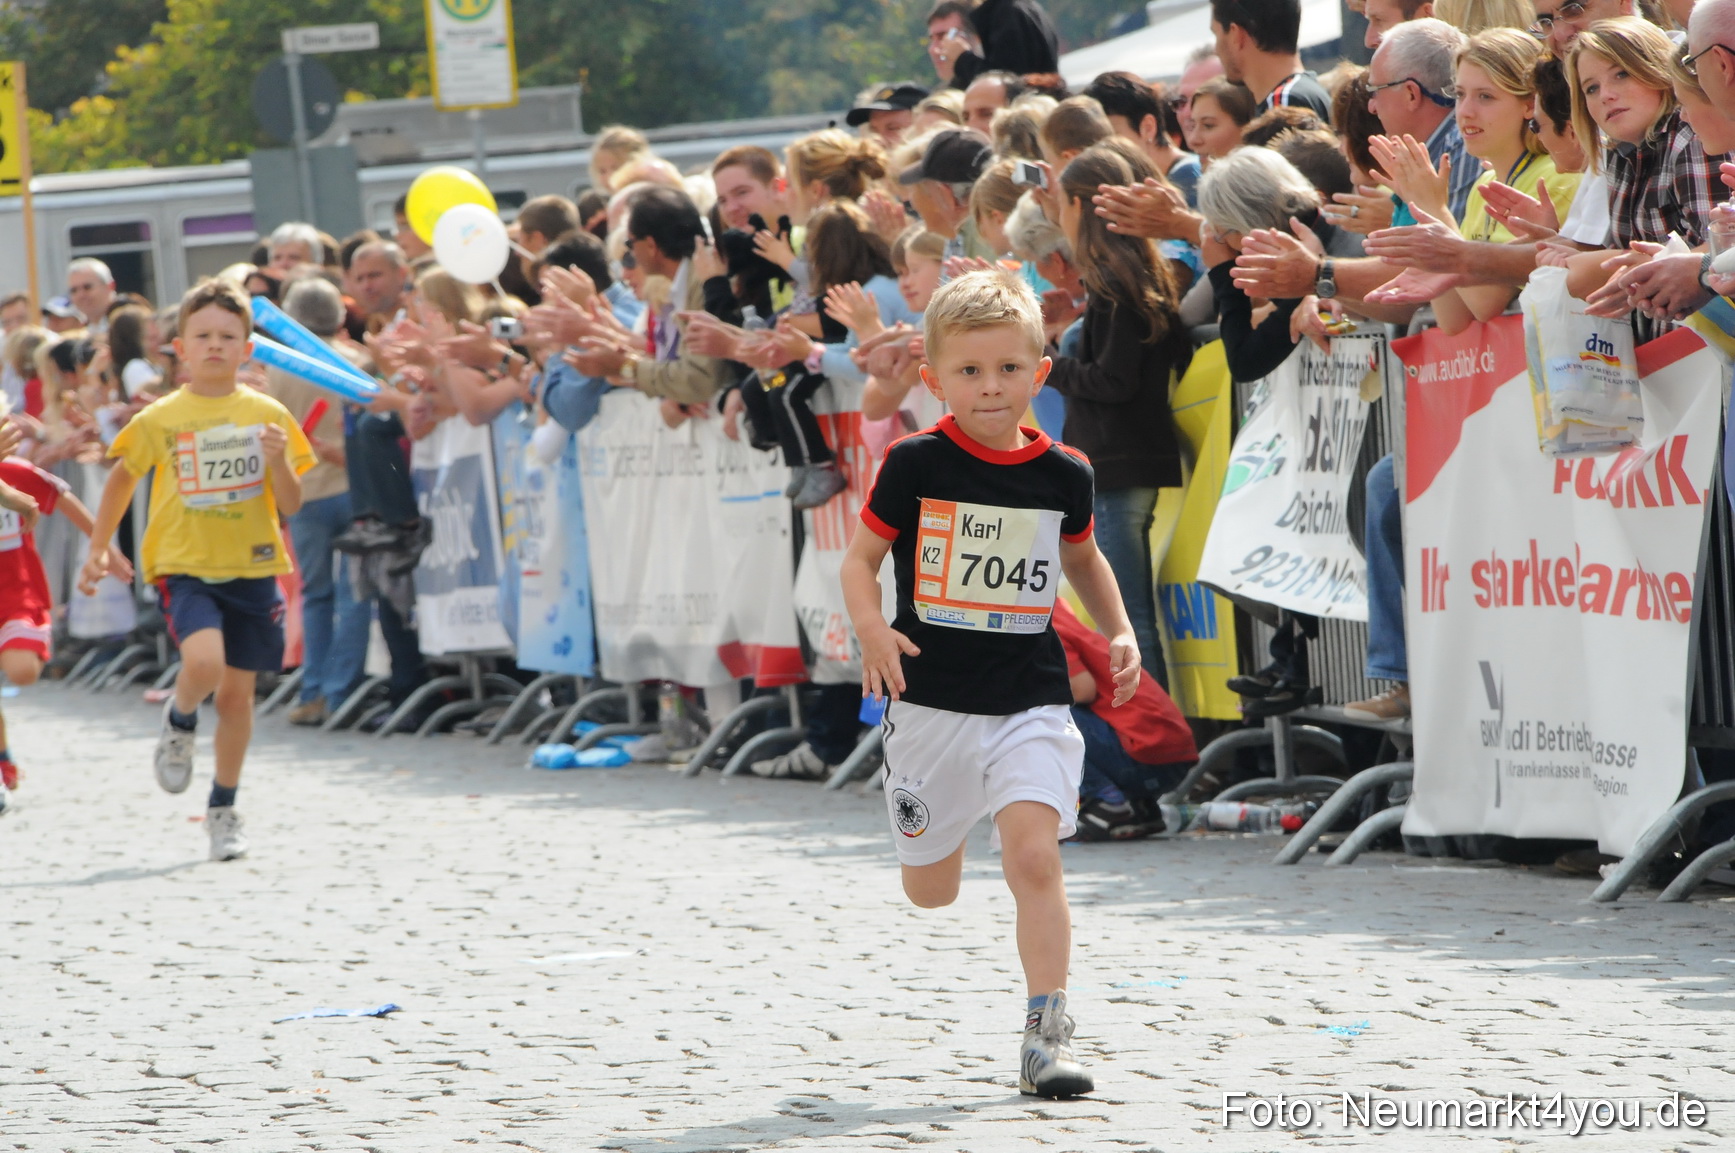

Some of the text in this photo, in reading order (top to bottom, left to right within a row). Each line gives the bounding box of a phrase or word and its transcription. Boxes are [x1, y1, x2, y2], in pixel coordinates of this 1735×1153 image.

[1585, 333, 1614, 356] dm
[204, 455, 260, 480] 7200
[961, 513, 1002, 540] Karl
[922, 545, 941, 565] K2
[960, 553, 1049, 592] 7045
[1230, 545, 1328, 597] 92318
[1421, 547, 1449, 613] Ihr
[1004, 613, 1049, 626] PFLEIDERER
